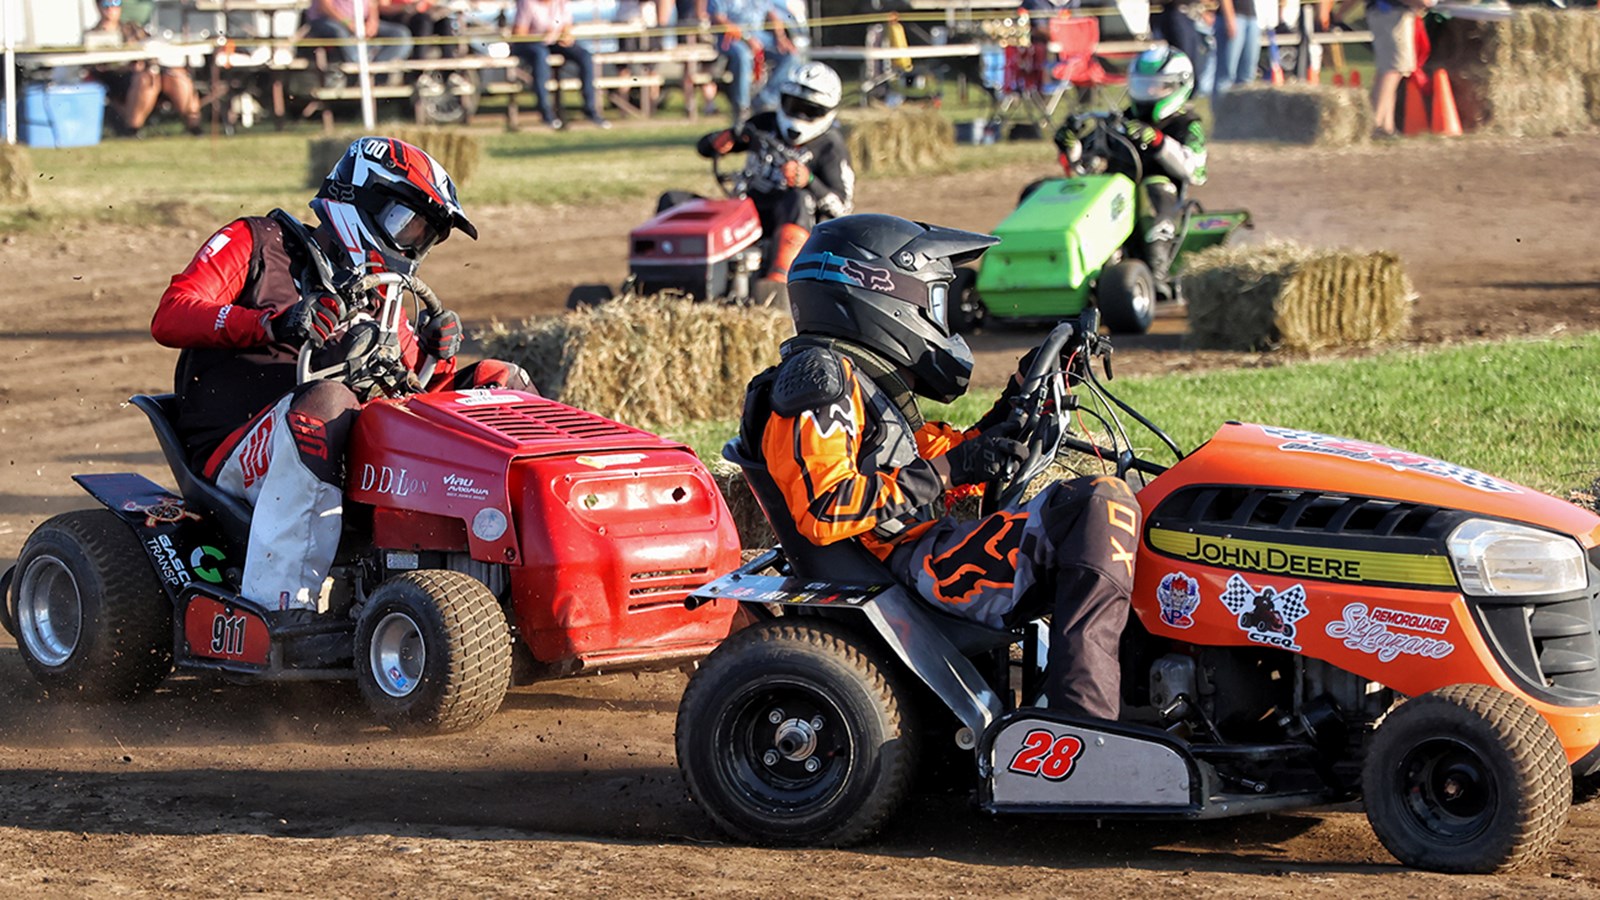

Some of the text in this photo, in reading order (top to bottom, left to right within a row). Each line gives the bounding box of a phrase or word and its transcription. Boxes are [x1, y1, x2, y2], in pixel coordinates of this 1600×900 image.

[1186, 536, 1361, 579] JOHN DEERE
[211, 613, 247, 655] 911
[1371, 609, 1447, 632] REMORQUAGE
[1007, 727, 1086, 782] 28
